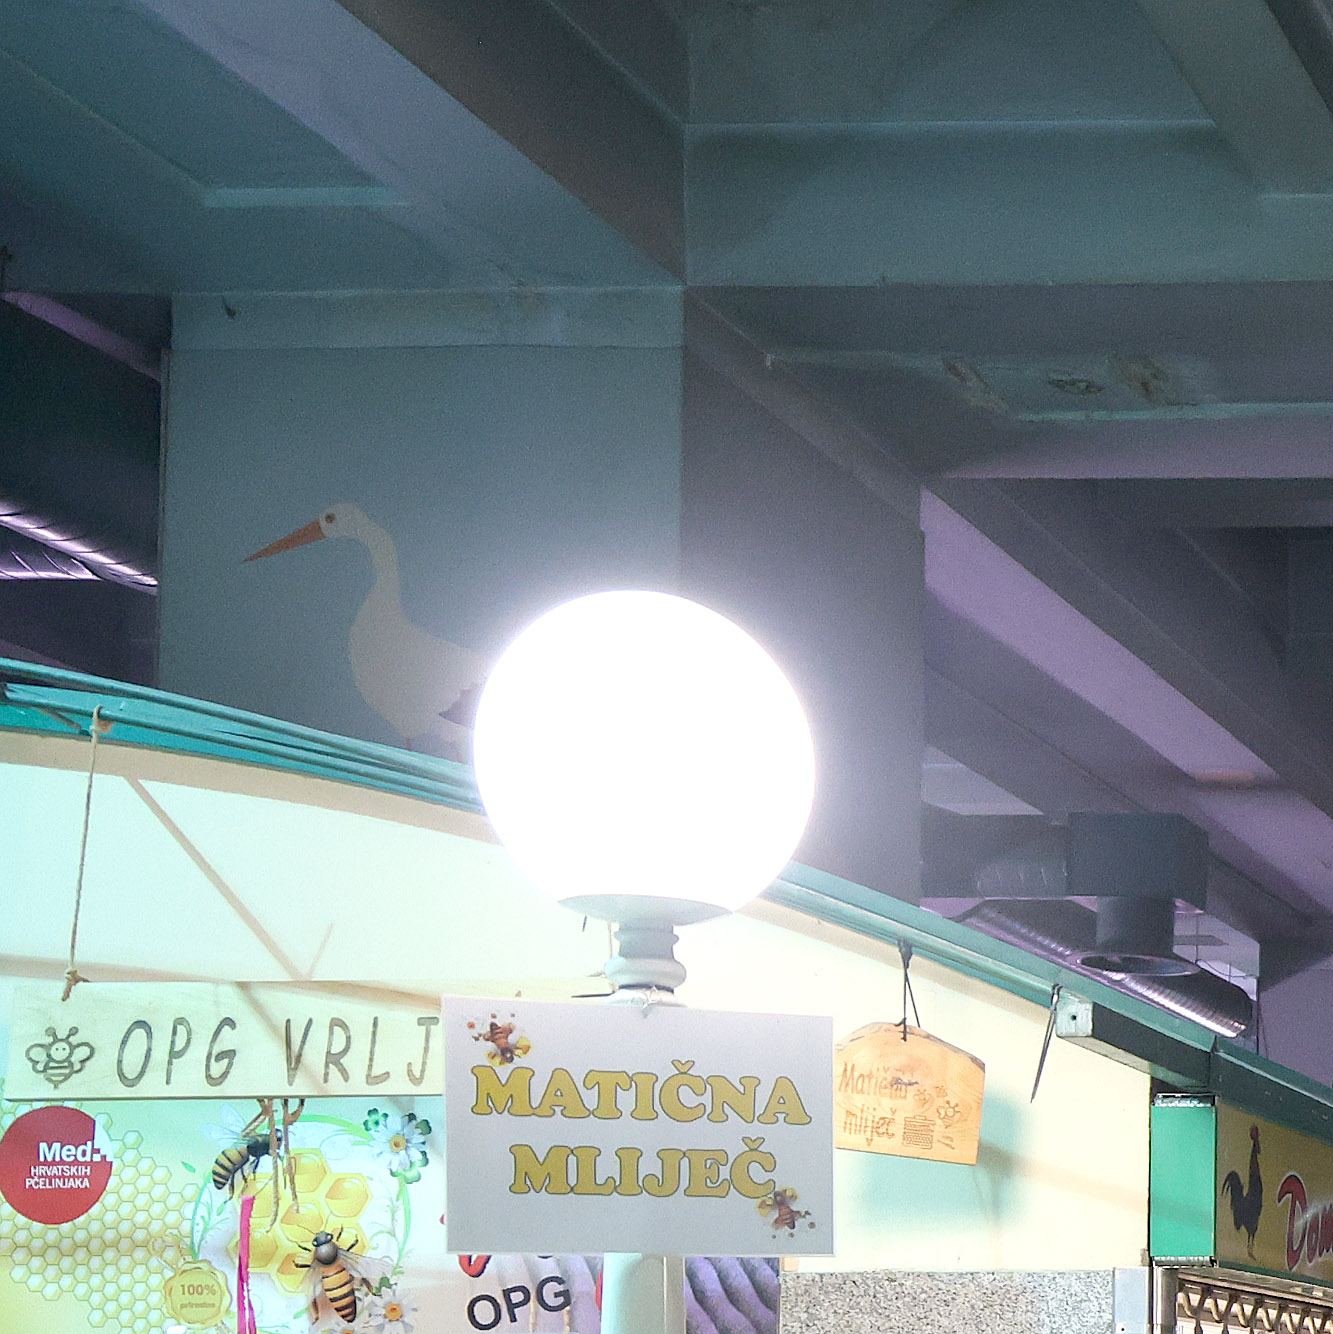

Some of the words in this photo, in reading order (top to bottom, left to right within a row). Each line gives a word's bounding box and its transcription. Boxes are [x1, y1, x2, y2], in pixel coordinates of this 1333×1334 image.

[116, 1016, 237, 1088] OPG
[284, 1015, 440, 1087] VRLJ
[471, 1060, 812, 1125] MATIČNA
[25, 1176, 91, 1189] PČELINJAKA
[30, 1165, 91, 1177] HRVATSKIH
[508, 1137, 777, 1199] MLIJEČ
[180, 1284, 217, 1296] 100%
[467, 1276, 572, 1330] OPG
